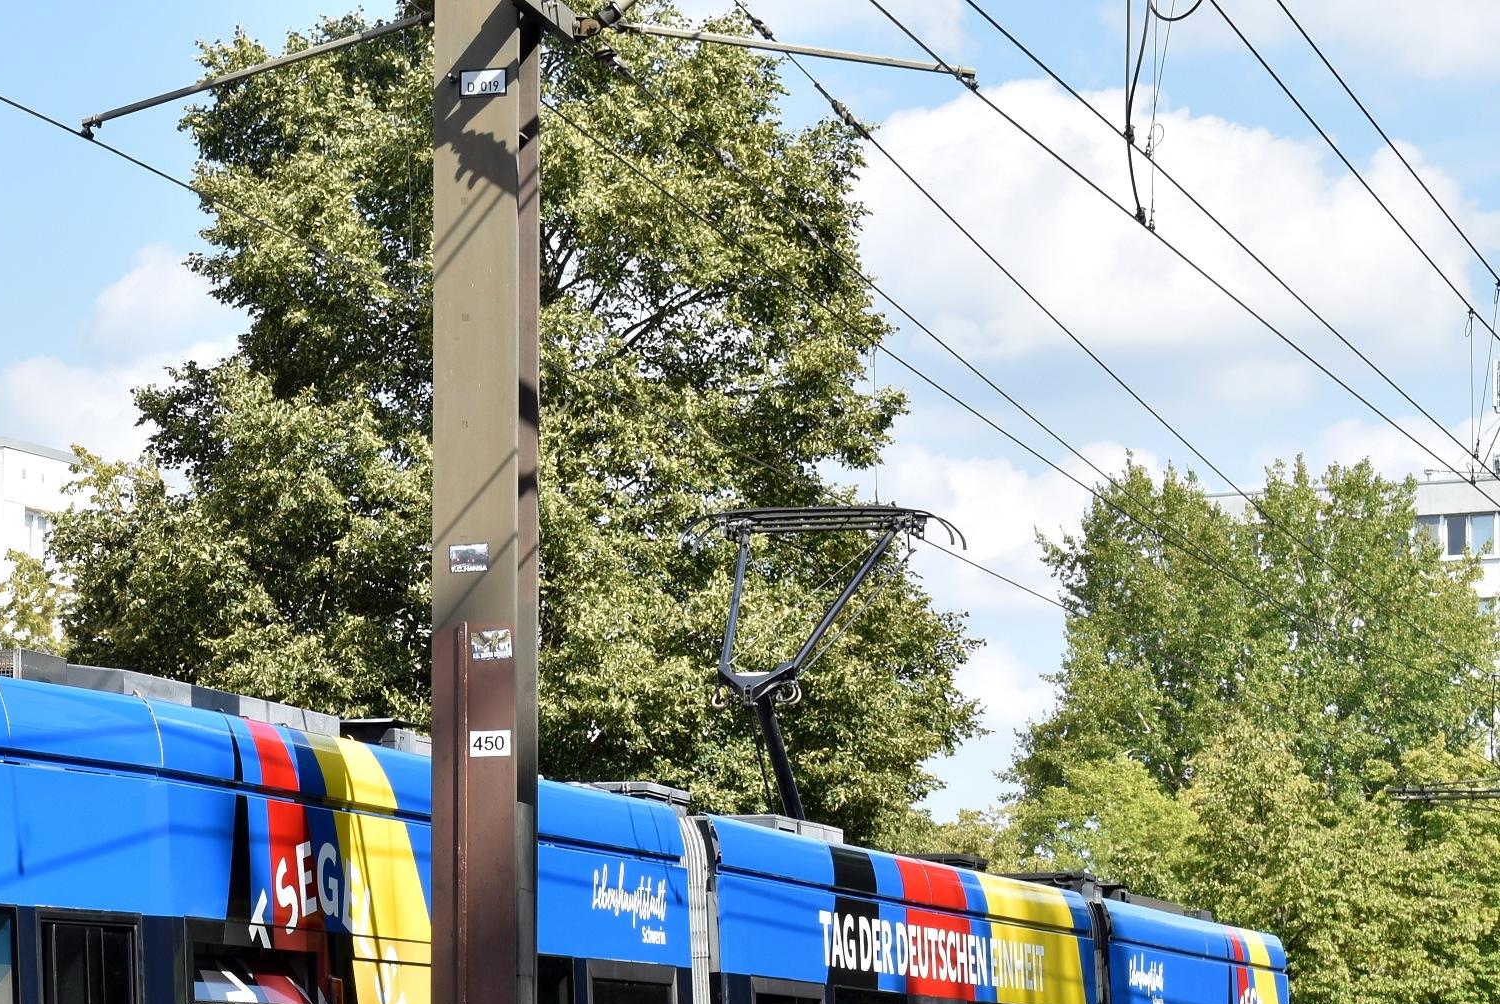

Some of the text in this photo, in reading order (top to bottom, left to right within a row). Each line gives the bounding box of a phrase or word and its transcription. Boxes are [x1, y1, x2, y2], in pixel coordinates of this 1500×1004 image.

[467, 80, 500, 93] D 019
[472, 735, 505, 751] 450
[818, 910, 1045, 992] TAG DER DEUTSCHEN EINHEIT
